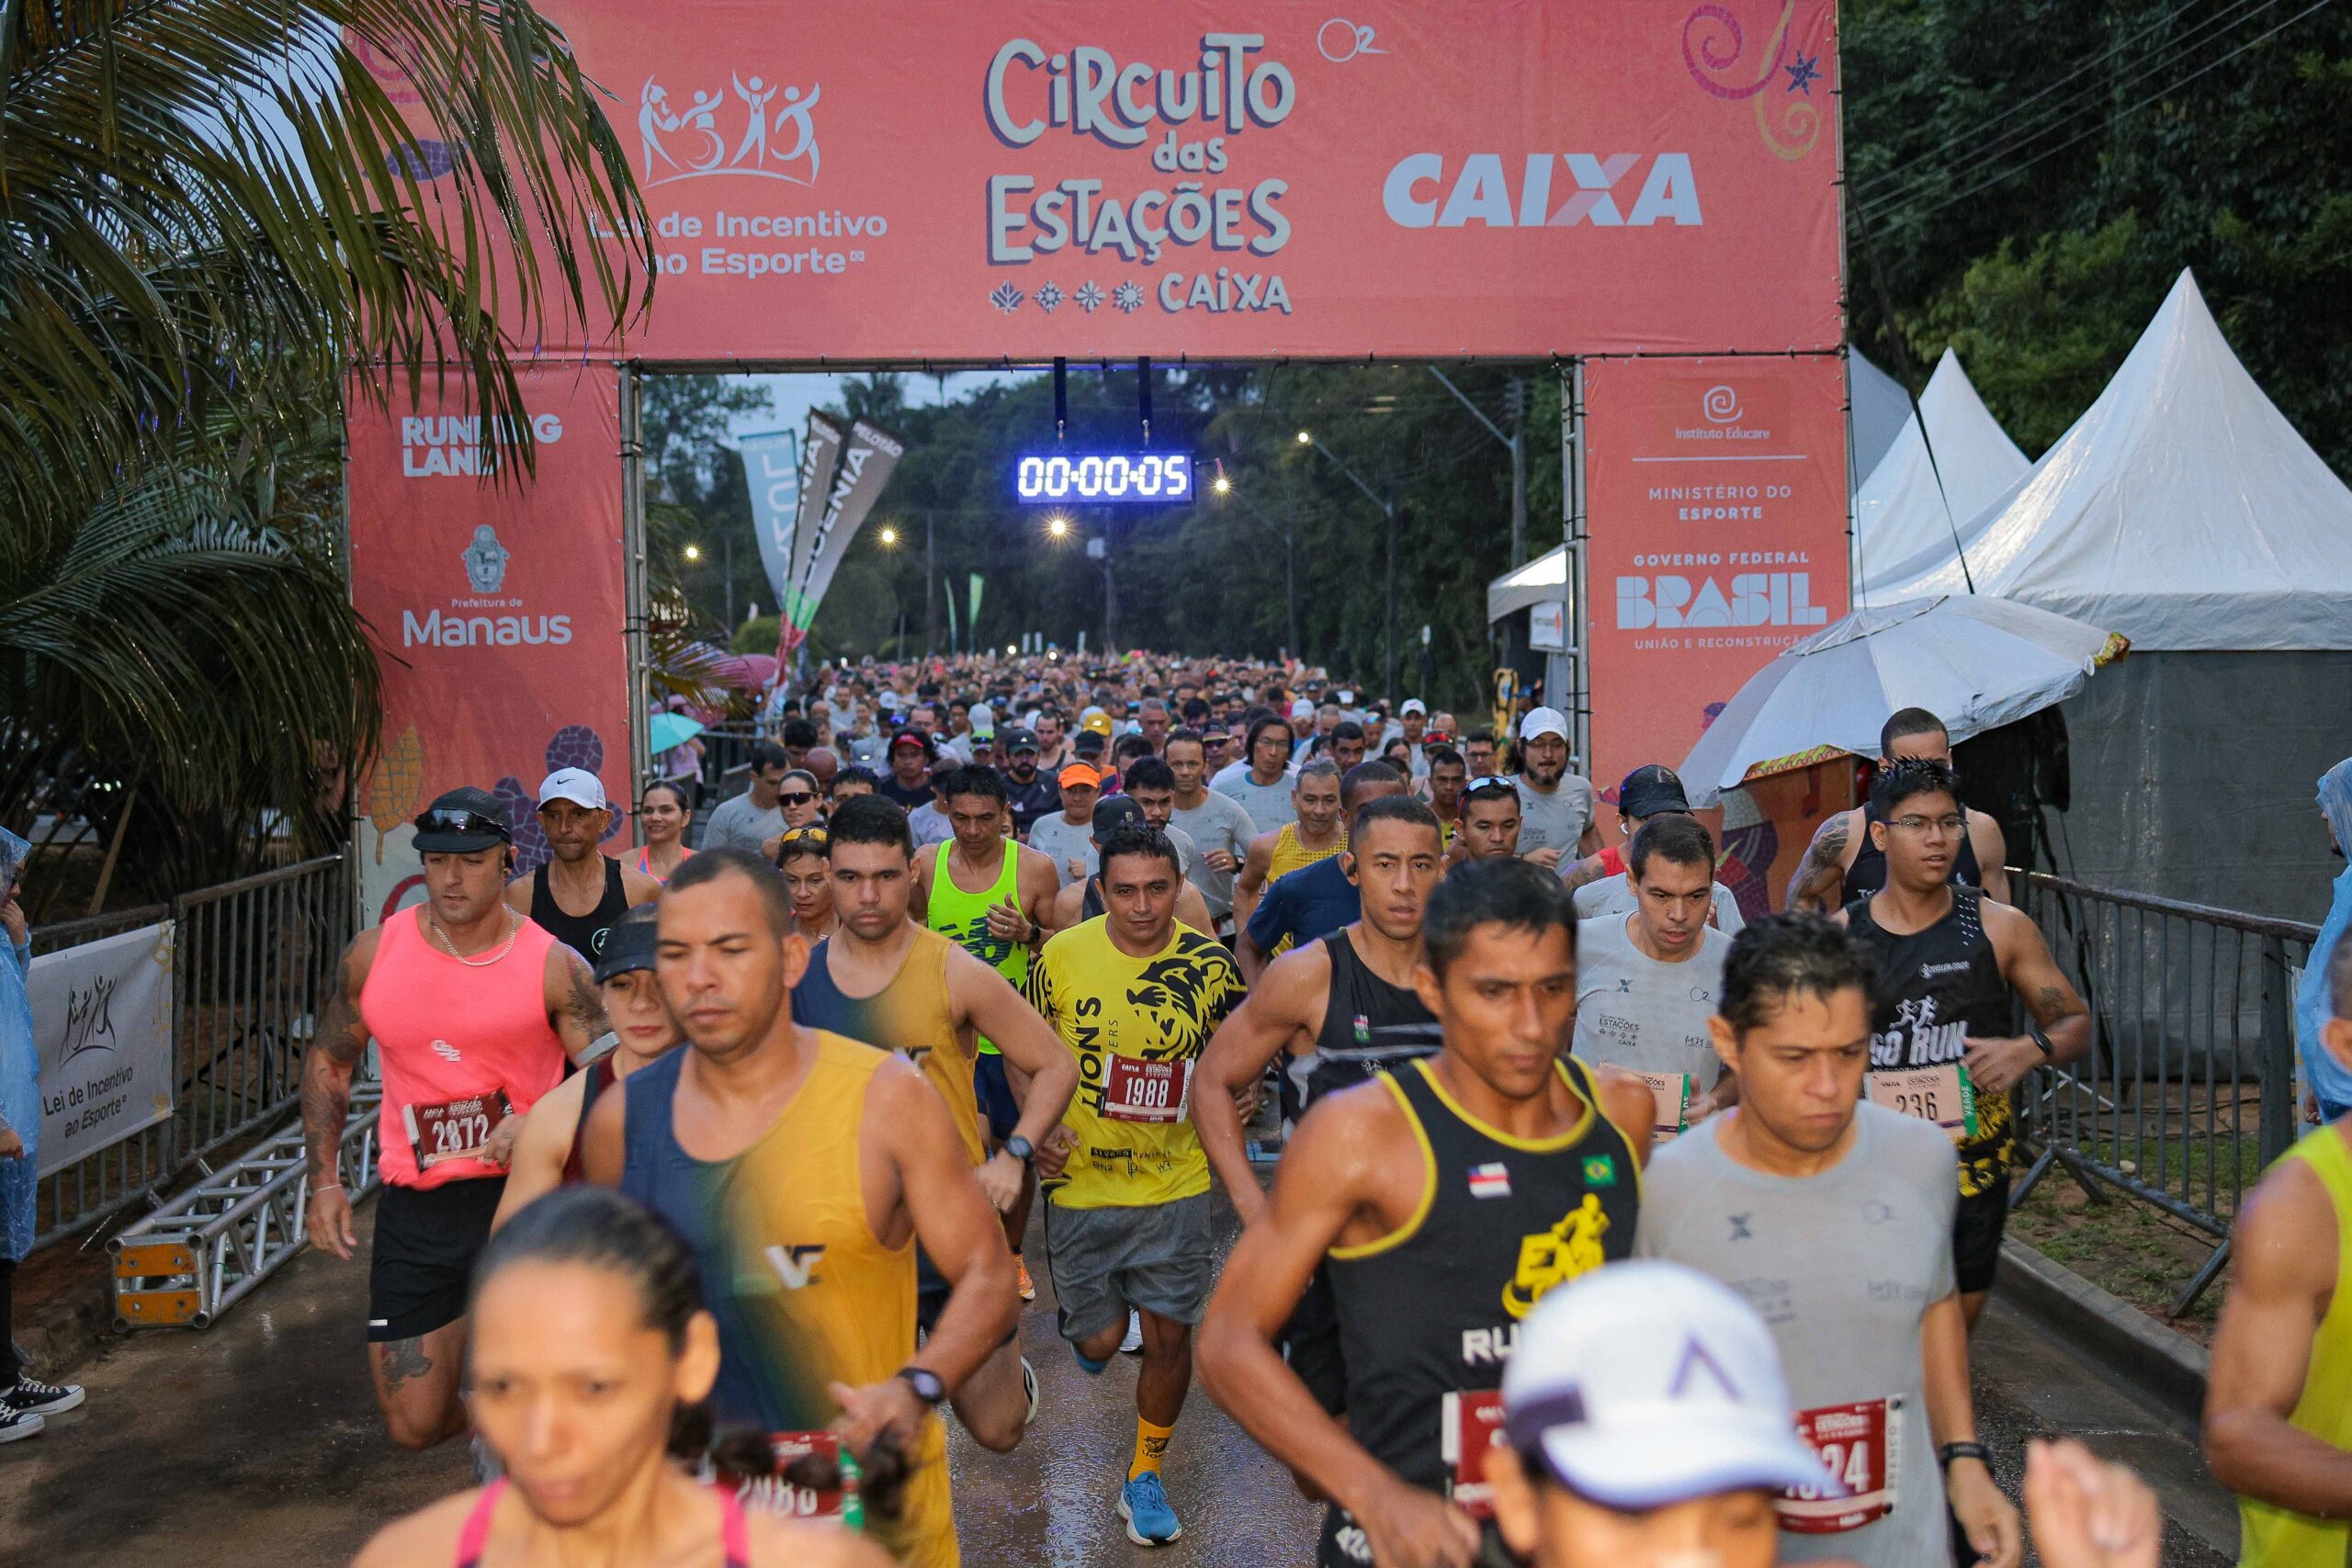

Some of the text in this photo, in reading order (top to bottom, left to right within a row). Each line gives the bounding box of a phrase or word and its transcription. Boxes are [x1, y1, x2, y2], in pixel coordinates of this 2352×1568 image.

[1152, 130, 1228, 175] das
[1383, 152, 1702, 229] CAIXA
[658, 211, 704, 238] de
[716, 209, 888, 238] Incentivo
[986, 175, 1291, 267] ESTAÇÕES
[701, 247, 846, 279] Esporte
[1675, 427, 1723, 440] Instituto
[1018, 456, 1187, 497] 00:00:05
[1649, 484, 1792, 501] MINISTÉRIO DO
[1679, 507, 1763, 521] ESPORTE
[1633, 551, 1809, 567] GOVERNO FEDERAL
[451, 598, 523, 608] Prefeitura de
[1616, 572, 1827, 629] BRASIL
[402, 610, 572, 647] Manaus
[1634, 634, 1808, 649] UNIÃO E RECONSTRUÇÃ
[1909, 1021, 1969, 1066] RUN
[43, 1066, 133, 1116] Lei de Incentivo
[1125, 1077, 1170, 1108] 1988
[1895, 1091, 1938, 1121] 236
[64, 1098, 121, 1138] ao Esporte
[432, 1114, 491, 1154] 2872
